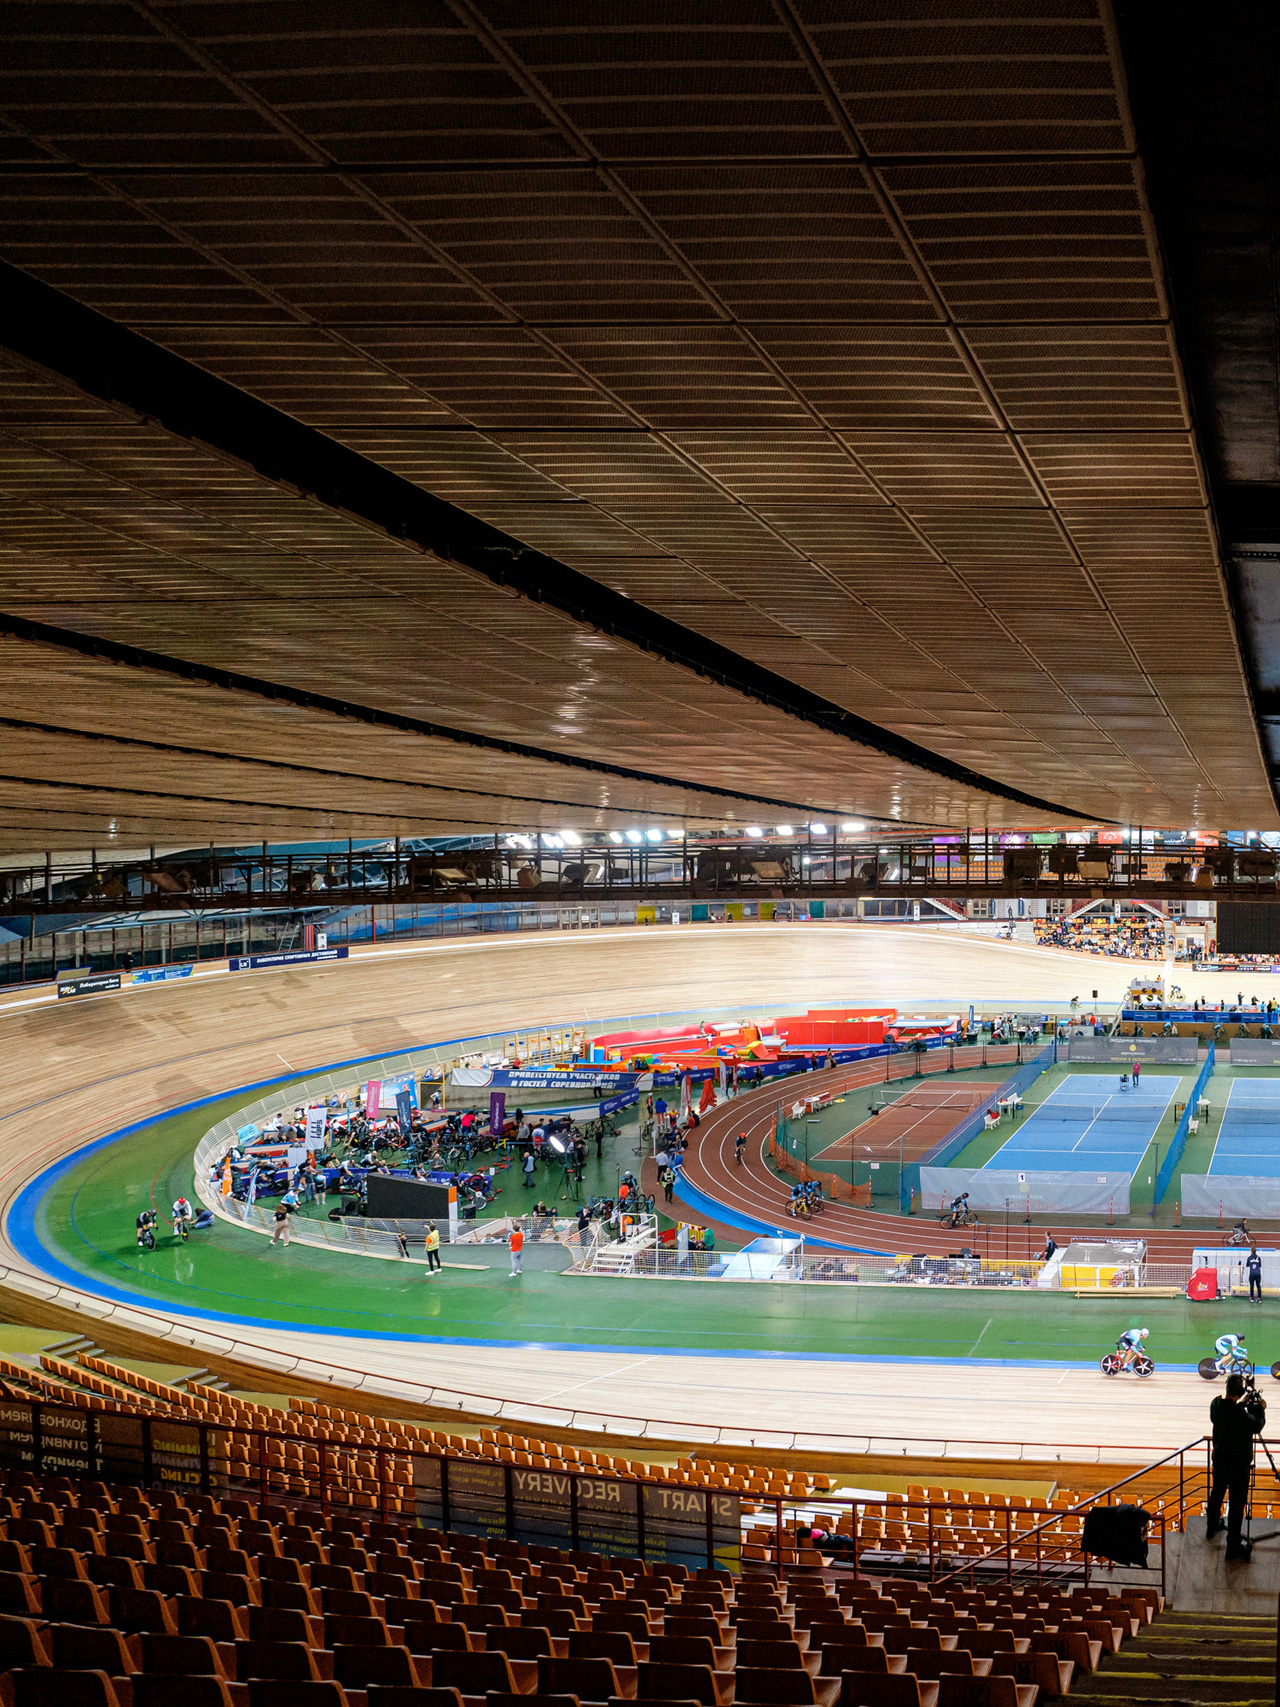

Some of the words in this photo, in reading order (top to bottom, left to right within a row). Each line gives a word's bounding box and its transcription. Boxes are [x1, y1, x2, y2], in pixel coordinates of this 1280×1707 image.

[508, 1071, 567, 1080] ПРИВЕТСТВУЕМ
[569, 1072, 620, 1080] УЧАСТИКОВ
[519, 1079, 547, 1087] ГОСТЕЙ
[550, 1081, 616, 1089] СОРЕВНОВАИЙ!
